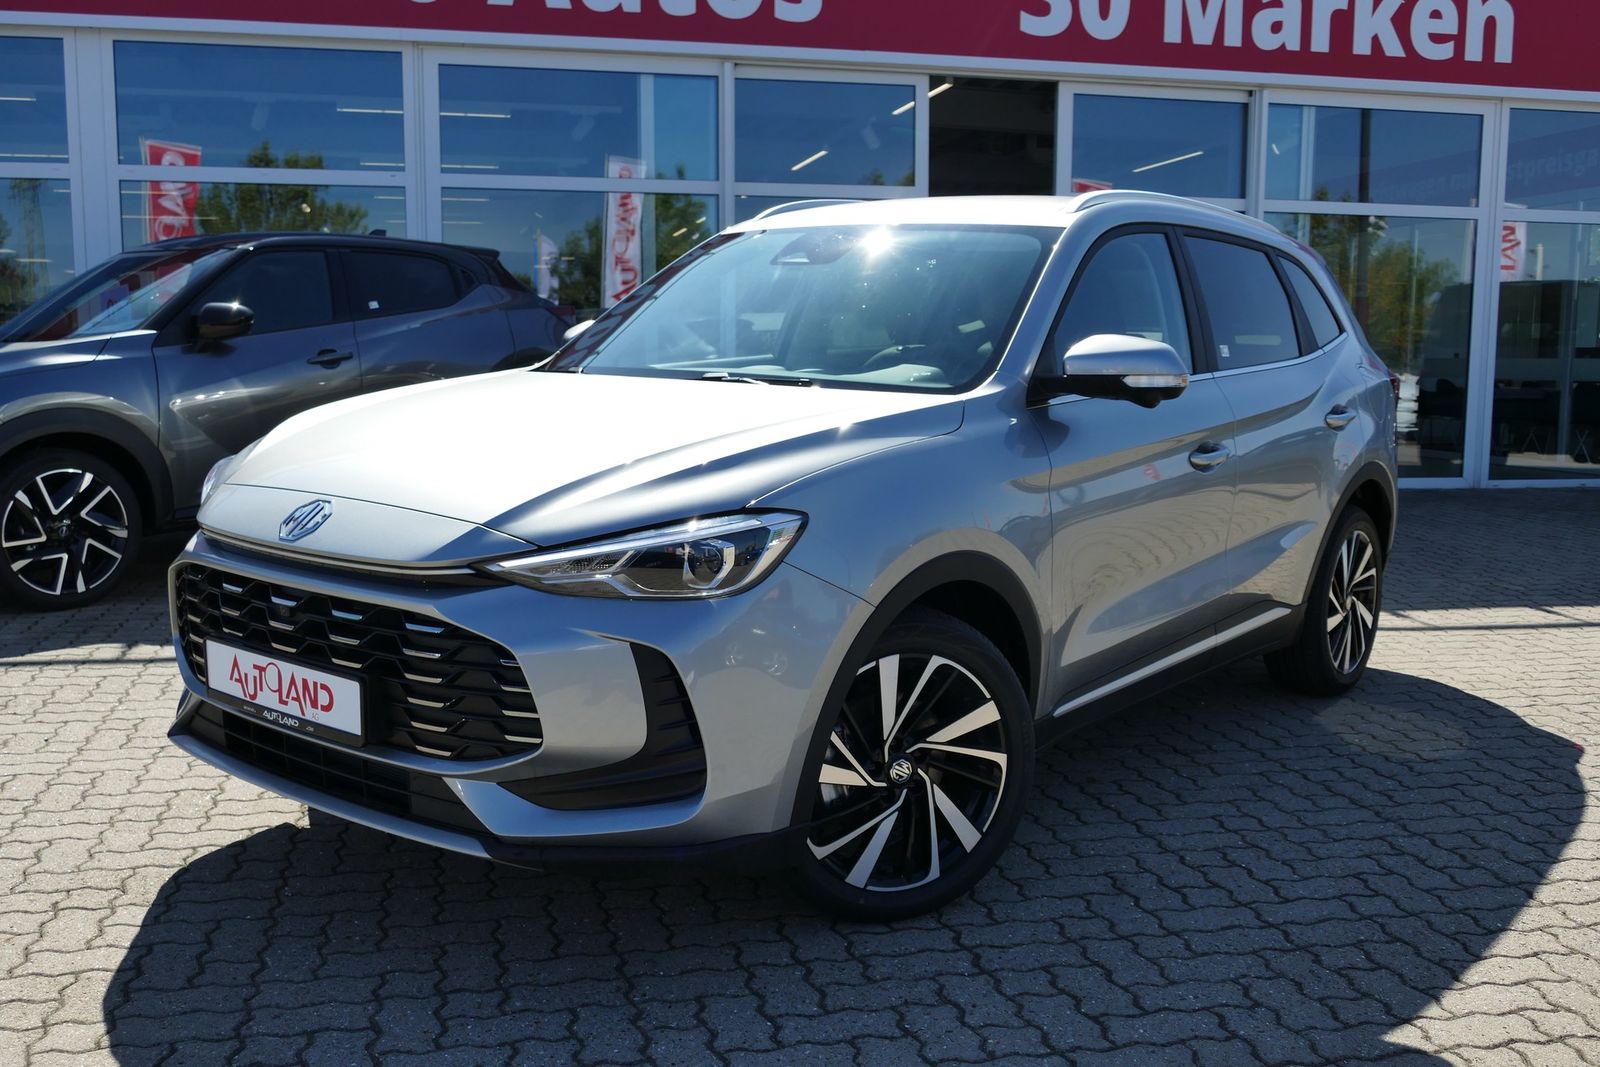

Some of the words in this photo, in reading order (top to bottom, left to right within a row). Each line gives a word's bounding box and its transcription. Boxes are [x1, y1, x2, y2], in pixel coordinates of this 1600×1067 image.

[1163, 0, 1515, 63] Marken
[229, 653, 335, 717] AUTOLAND
[263, 709, 299, 727] AUTOLAND
